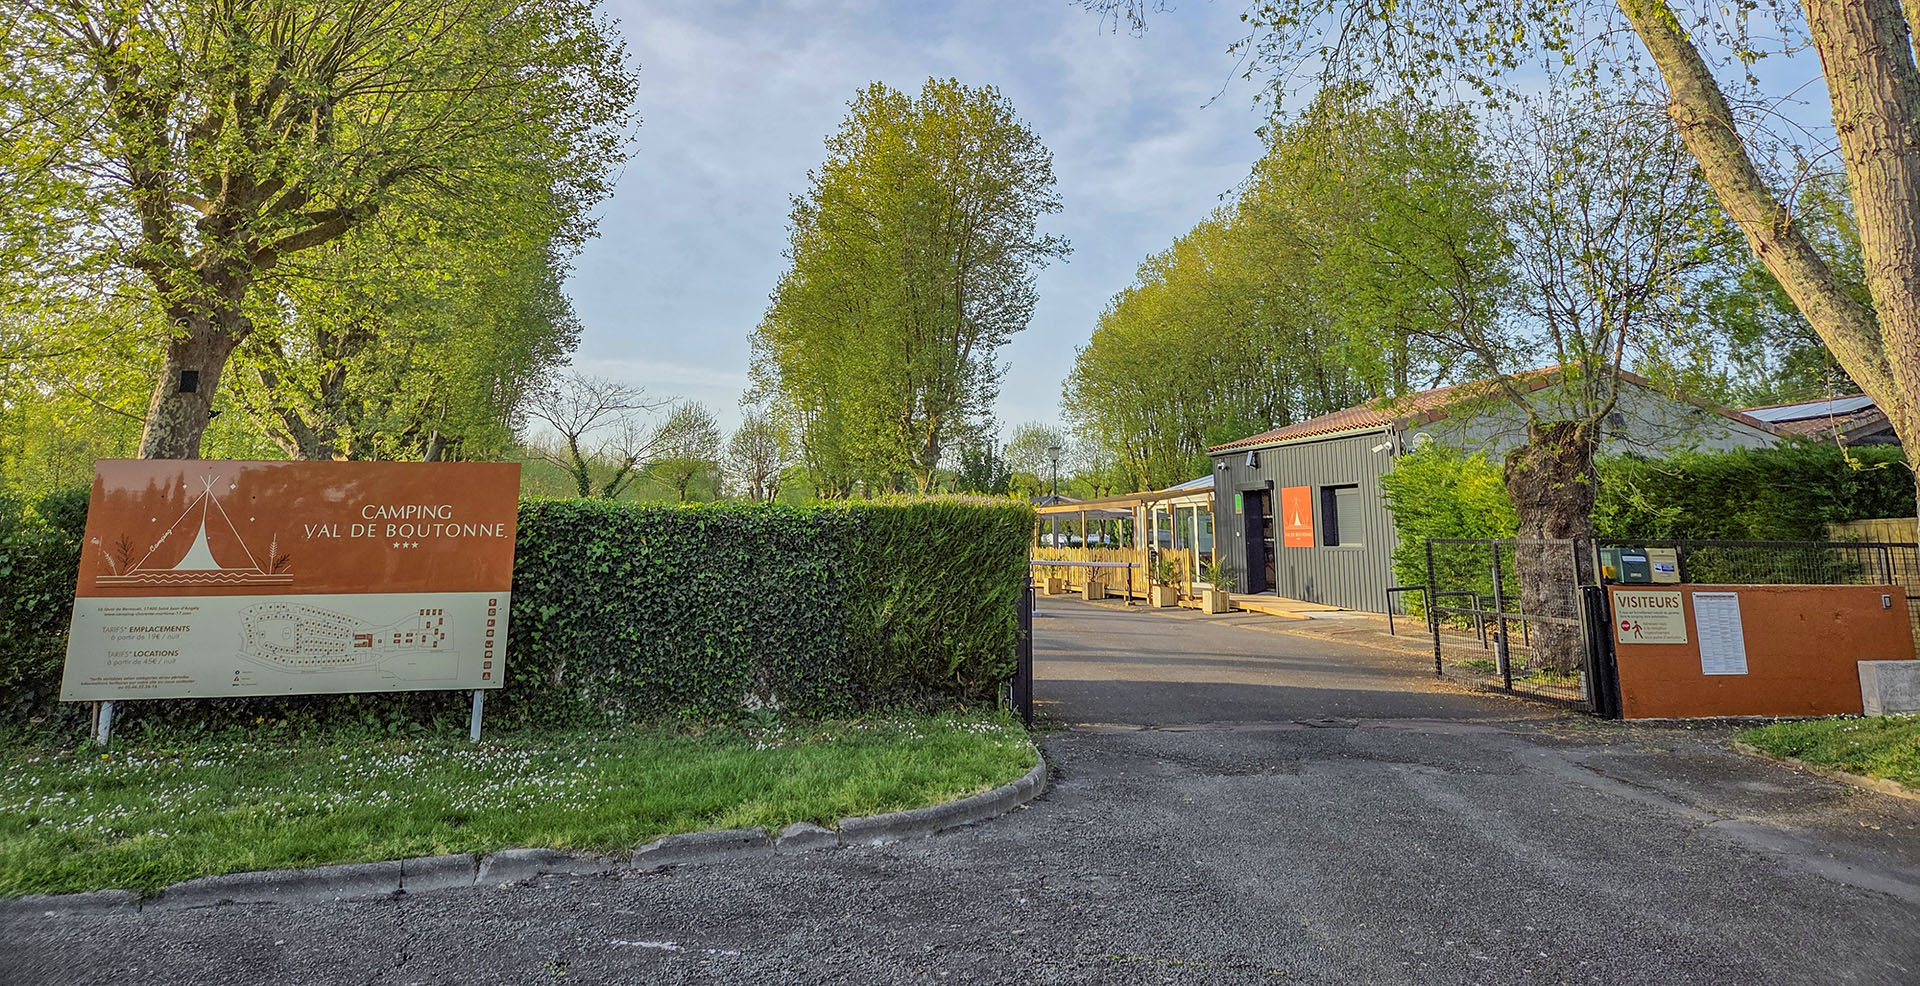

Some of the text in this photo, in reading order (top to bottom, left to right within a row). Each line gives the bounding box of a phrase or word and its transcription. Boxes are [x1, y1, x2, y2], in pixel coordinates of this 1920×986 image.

[361, 504, 453, 520] CAMPING
[304, 523, 506, 539] VAL DE BOUTONNE
[1617, 595, 1680, 609] VISITEURS
[129, 625, 191, 633] EMPLACEMENTS
[116, 634, 135, 642] partir
[133, 649, 180, 658] LOCATIONS
[113, 658, 132, 667] partir
